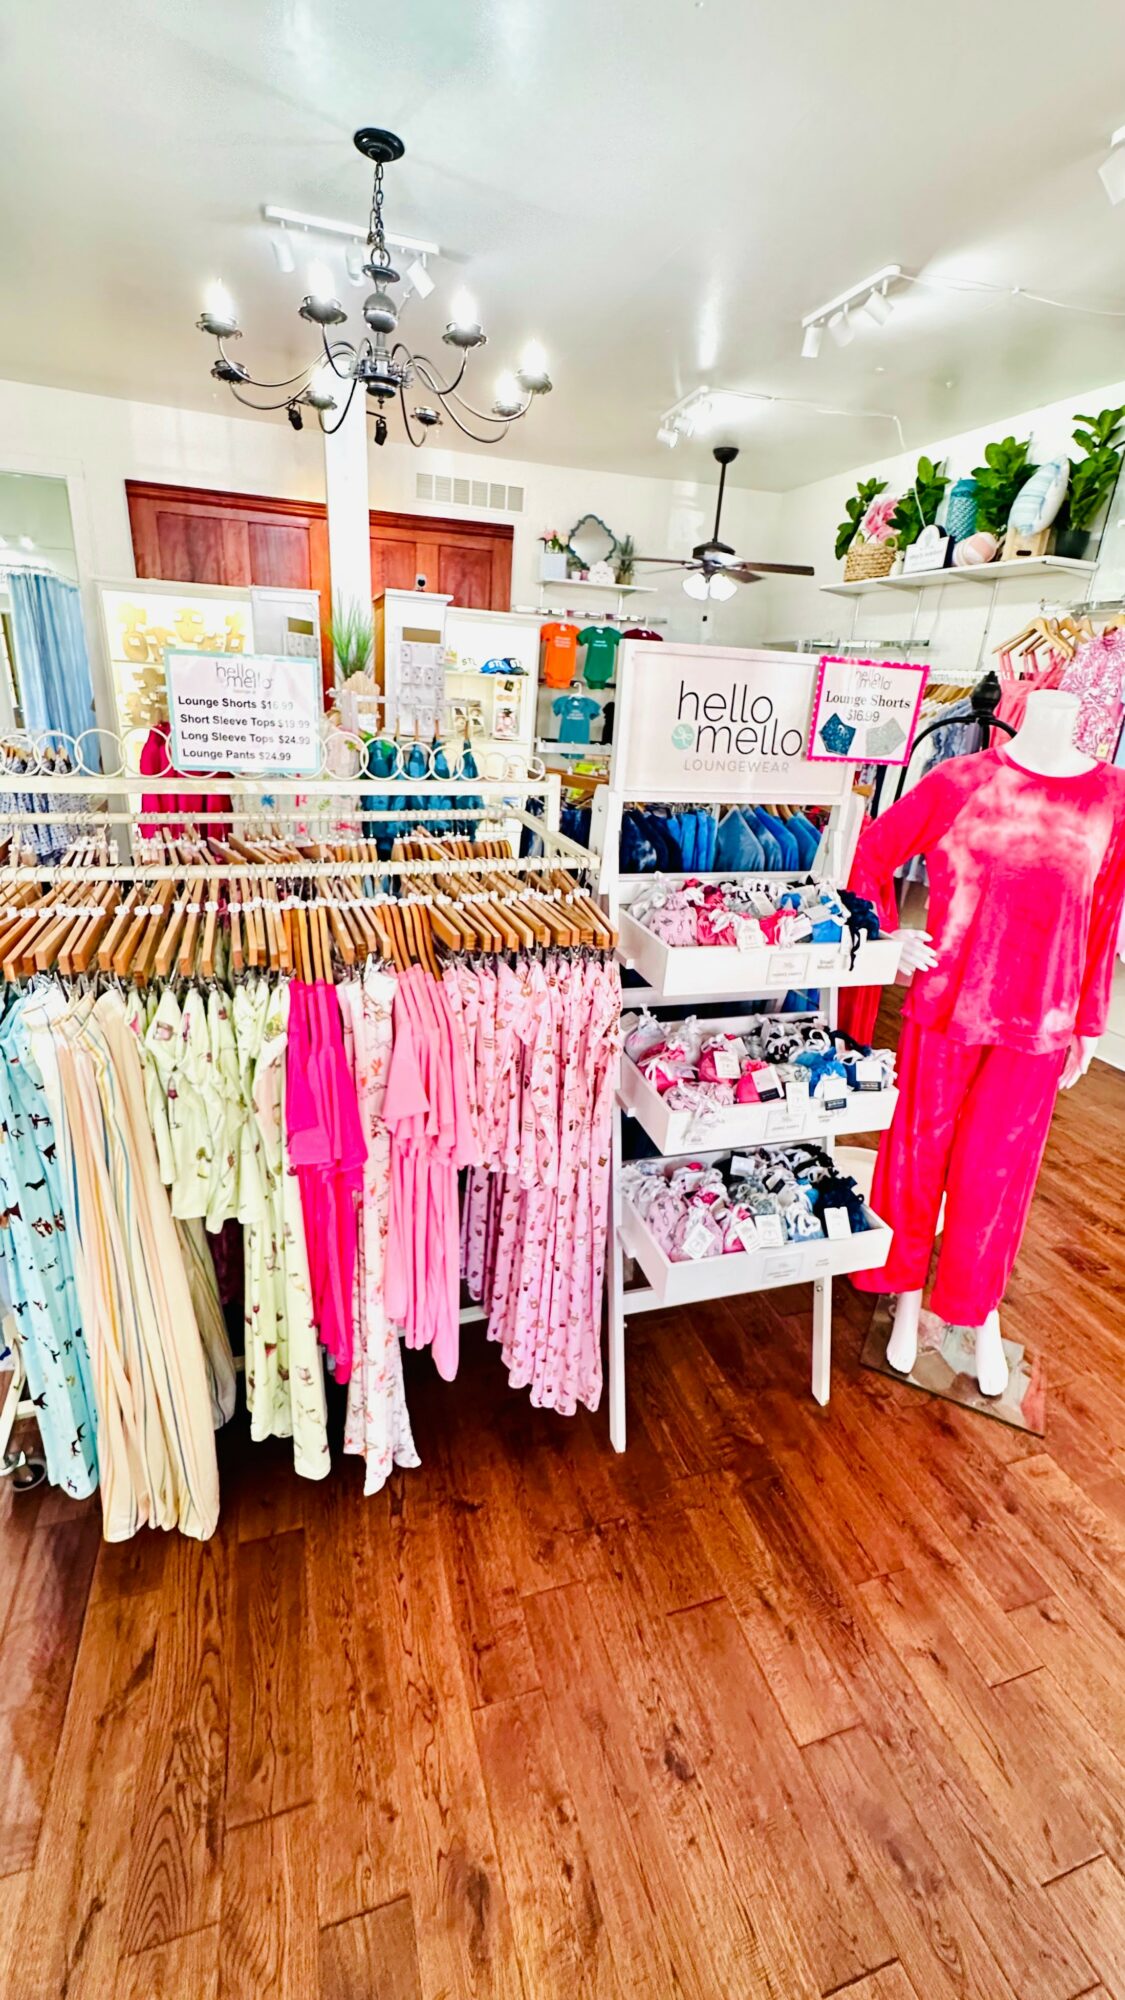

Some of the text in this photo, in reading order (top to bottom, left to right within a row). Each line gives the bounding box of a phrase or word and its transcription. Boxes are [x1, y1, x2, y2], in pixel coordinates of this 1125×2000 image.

[216, 661, 255, 678] hello
[227, 672, 272, 690] mello
[858, 675, 892, 690] mello
[178, 696, 219, 708] Lounge
[222, 698, 257, 709] Shorts
[677, 680, 773, 724] hello
[826, 690, 911, 709] Lounge Shorts
[180, 713, 209, 724] Short
[212, 715, 248, 727] Sleeve
[251, 717, 276, 728] Tops
[847, 709, 880, 723] $16.99
[181, 730, 311, 745] Long Sleeve Tops $24.99
[695, 718, 803, 757] mello
[182, 748, 291, 761] Lounge Pants $24.99
[684, 759, 790, 774] LOUNGEWEAR
